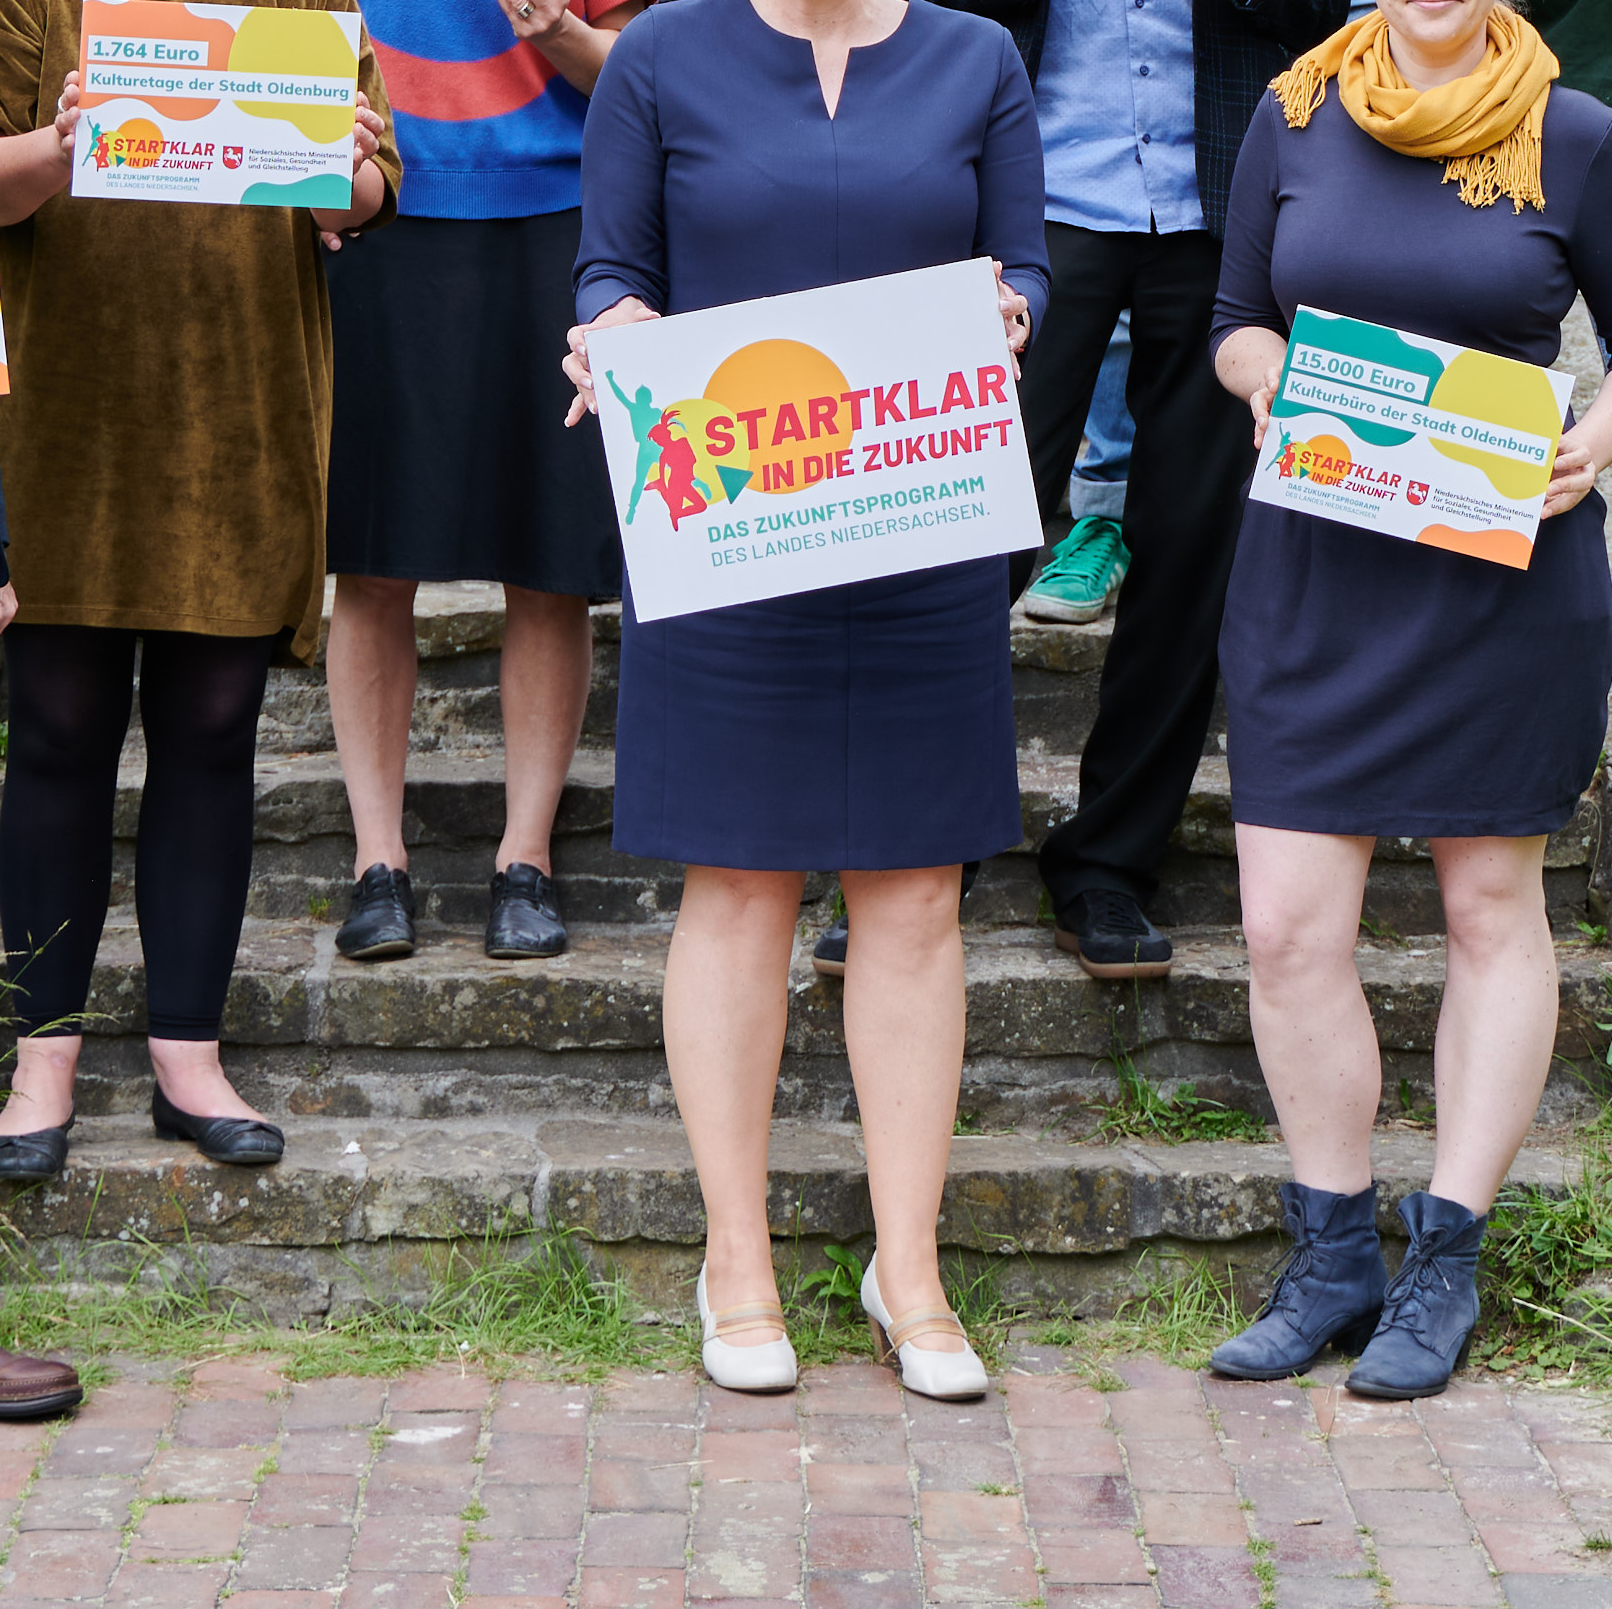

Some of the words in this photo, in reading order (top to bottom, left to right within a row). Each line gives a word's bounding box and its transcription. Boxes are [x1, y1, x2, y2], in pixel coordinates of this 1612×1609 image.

[93, 40, 147, 58] 1.764
[154, 43, 200, 61] Euro
[90, 72, 184, 92] Kulturetage
[188, 77, 215, 91] der
[218, 79, 263, 93] Stadt
[267, 81, 349, 102] Oldenburg
[113, 138, 215, 156] STARTKLAR
[106, 172, 121, 180] DAS
[122, 173, 200, 183] ZUKUNFTSPROGRAMM
[128, 157, 140, 167] IN
[141, 157, 160, 168] DIE
[162, 159, 213, 170] ZUKUNFT
[1297, 350, 1364, 380] 15.000
[1369, 368, 1416, 393] Euro
[705, 364, 1008, 457] STARTKLAR
[1289, 380, 1376, 413] Kulturbüro
[1380, 405, 1408, 421] der
[1410, 412, 1457, 435] Stadt
[1460, 425, 1545, 461] Oldenburg
[762, 459, 794, 492] IN
[802, 448, 855, 484] DIE
[862, 418, 1013, 472] ZUKUNFT
[1299, 450, 1402, 488] STARTKLAR
[1287, 482, 1302, 492] DAS
[1302, 486, 1380, 512] ZUKUNFTSPROGRAMM
[1311, 471, 1324, 483] IN
[1324, 475, 1344, 488] DIE
[1344, 480, 1397, 501] ZUKUNFT
[707, 520, 750, 543] DAS
[754, 475, 985, 534] ZUKUNFTSPROGRAMM
[1430, 503, 1445, 511] und
[1445, 506, 1492, 525] Gleichstellung
[1432, 494, 1443, 503] für
[1473, 505, 1511, 521] Gesundheit
[1434, 487, 1493, 509] Niedersächsisches
[1493, 503, 1534, 519] Ministerium
[710, 546, 748, 567] DES
[751, 531, 827, 560] LANDES
[830, 501, 990, 545] NIEDERSACHSEN.
